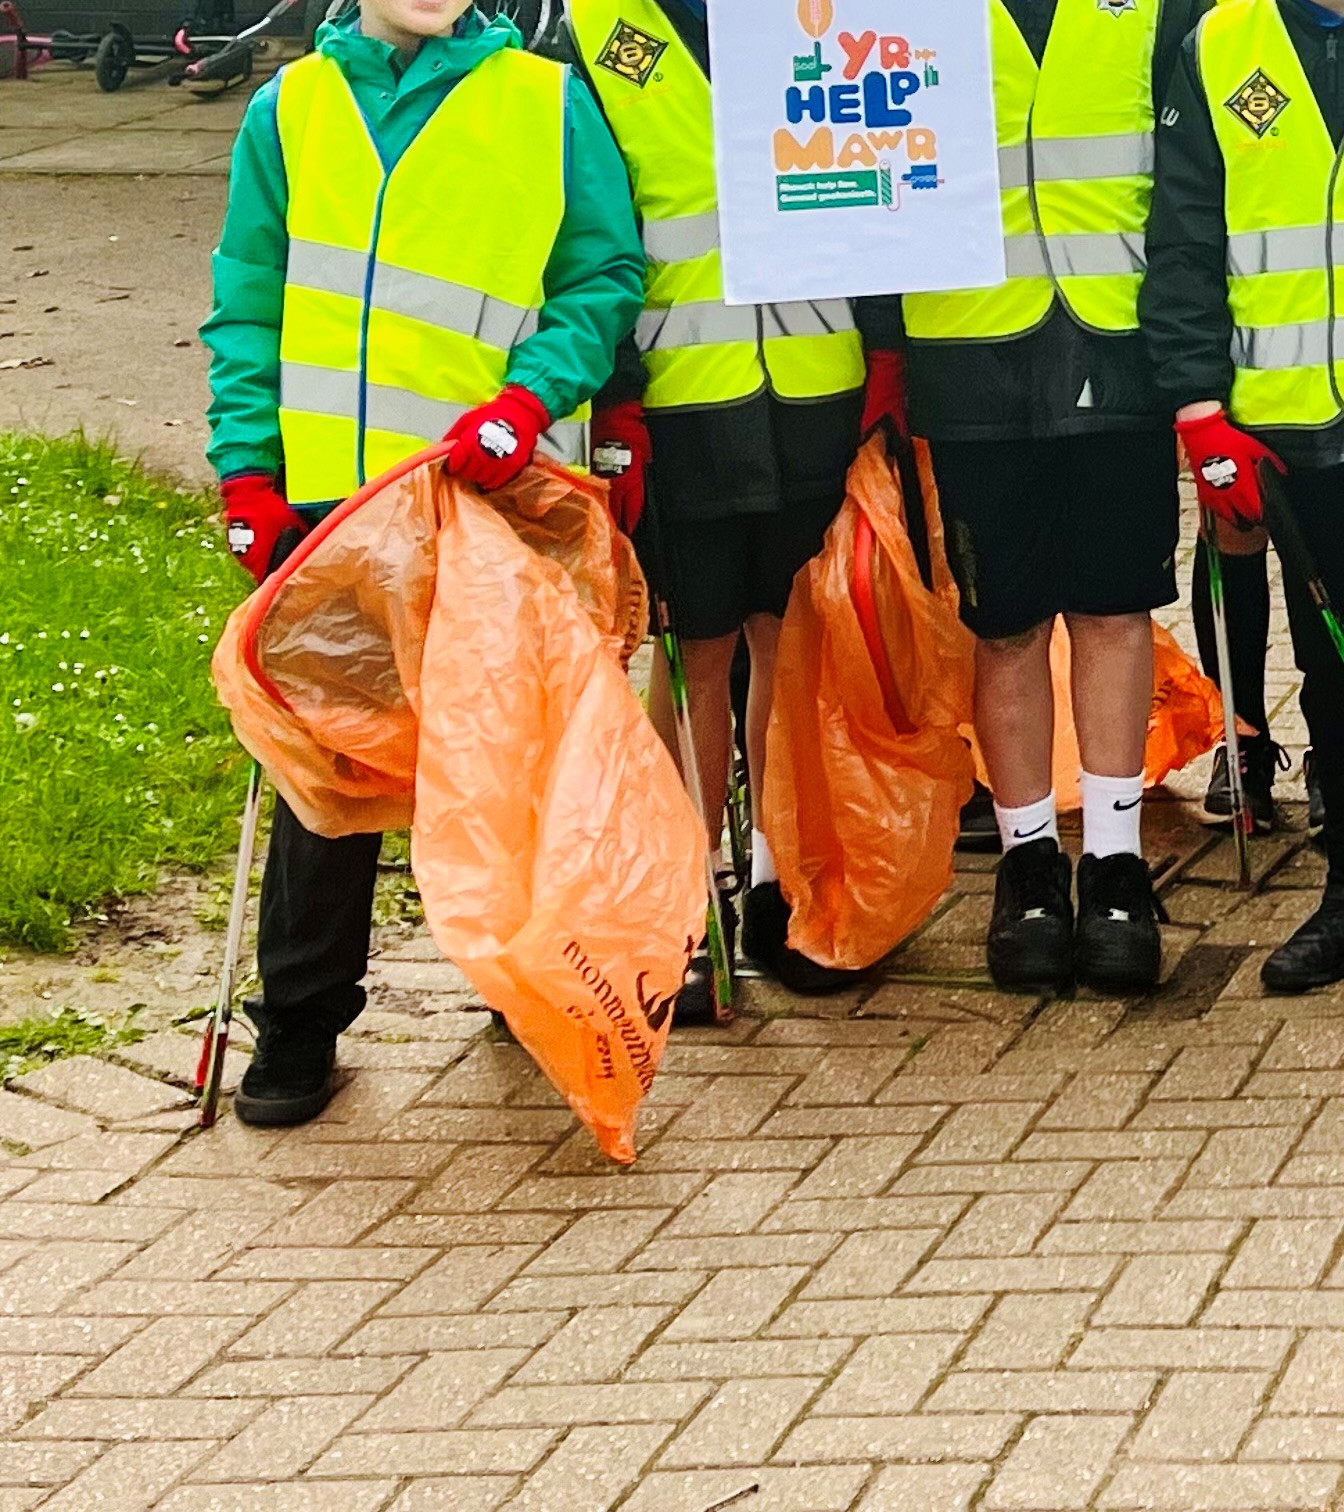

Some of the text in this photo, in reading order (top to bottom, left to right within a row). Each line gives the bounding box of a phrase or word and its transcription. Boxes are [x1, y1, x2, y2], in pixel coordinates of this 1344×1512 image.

[837, 30, 910, 80] YR
[785, 71, 921, 129] HELP
[773, 126, 938, 172] MAWR
